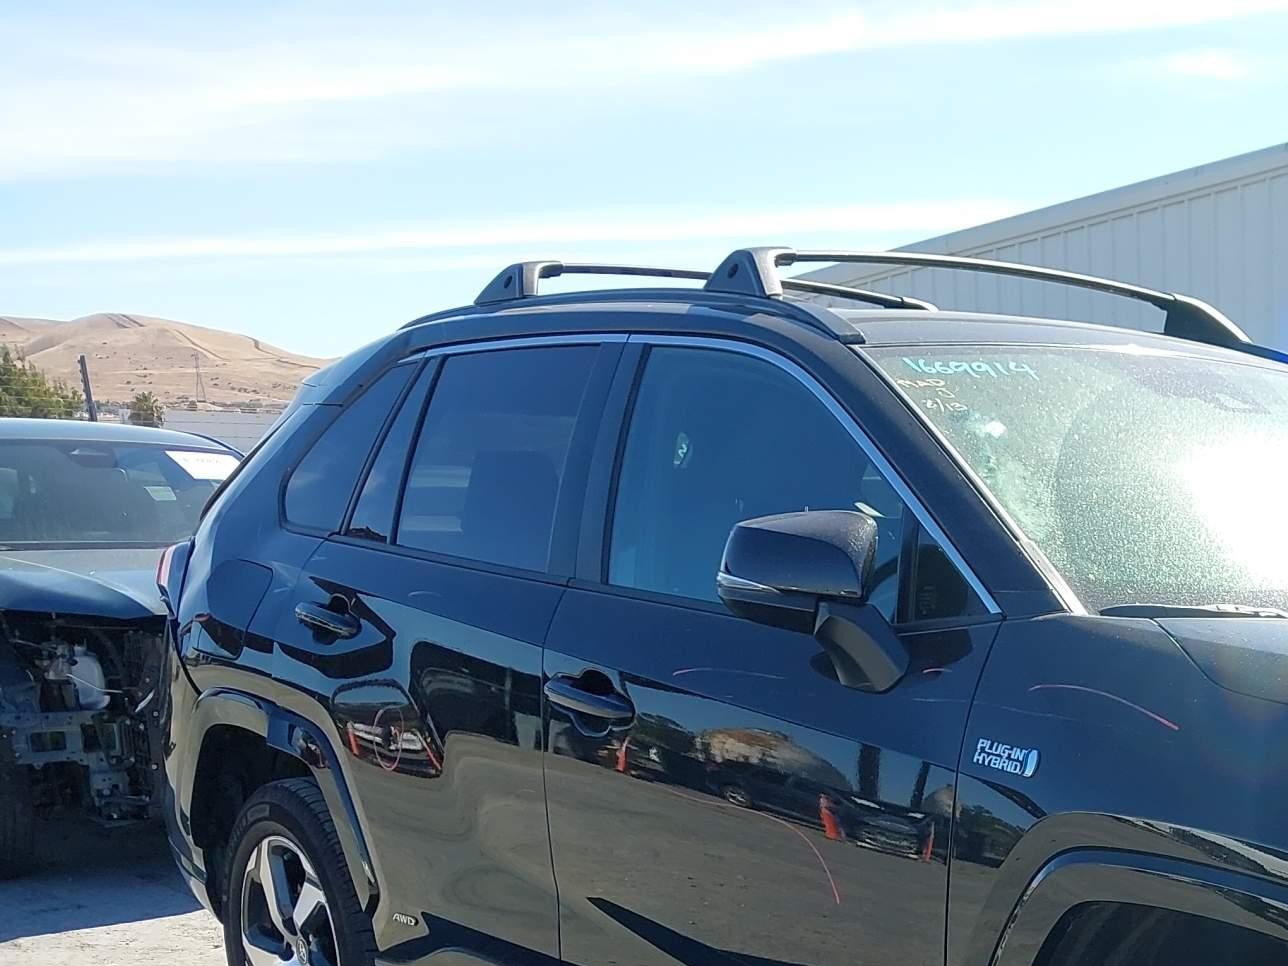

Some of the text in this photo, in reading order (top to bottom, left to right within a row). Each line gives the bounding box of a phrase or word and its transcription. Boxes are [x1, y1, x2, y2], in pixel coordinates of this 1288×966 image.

[902, 357, 1040, 380] 1669914
[977, 738, 1025, 761] PLUG-IN
[973, 751, 1021, 774] HYBRID
[392, 913, 416, 926] AWD
